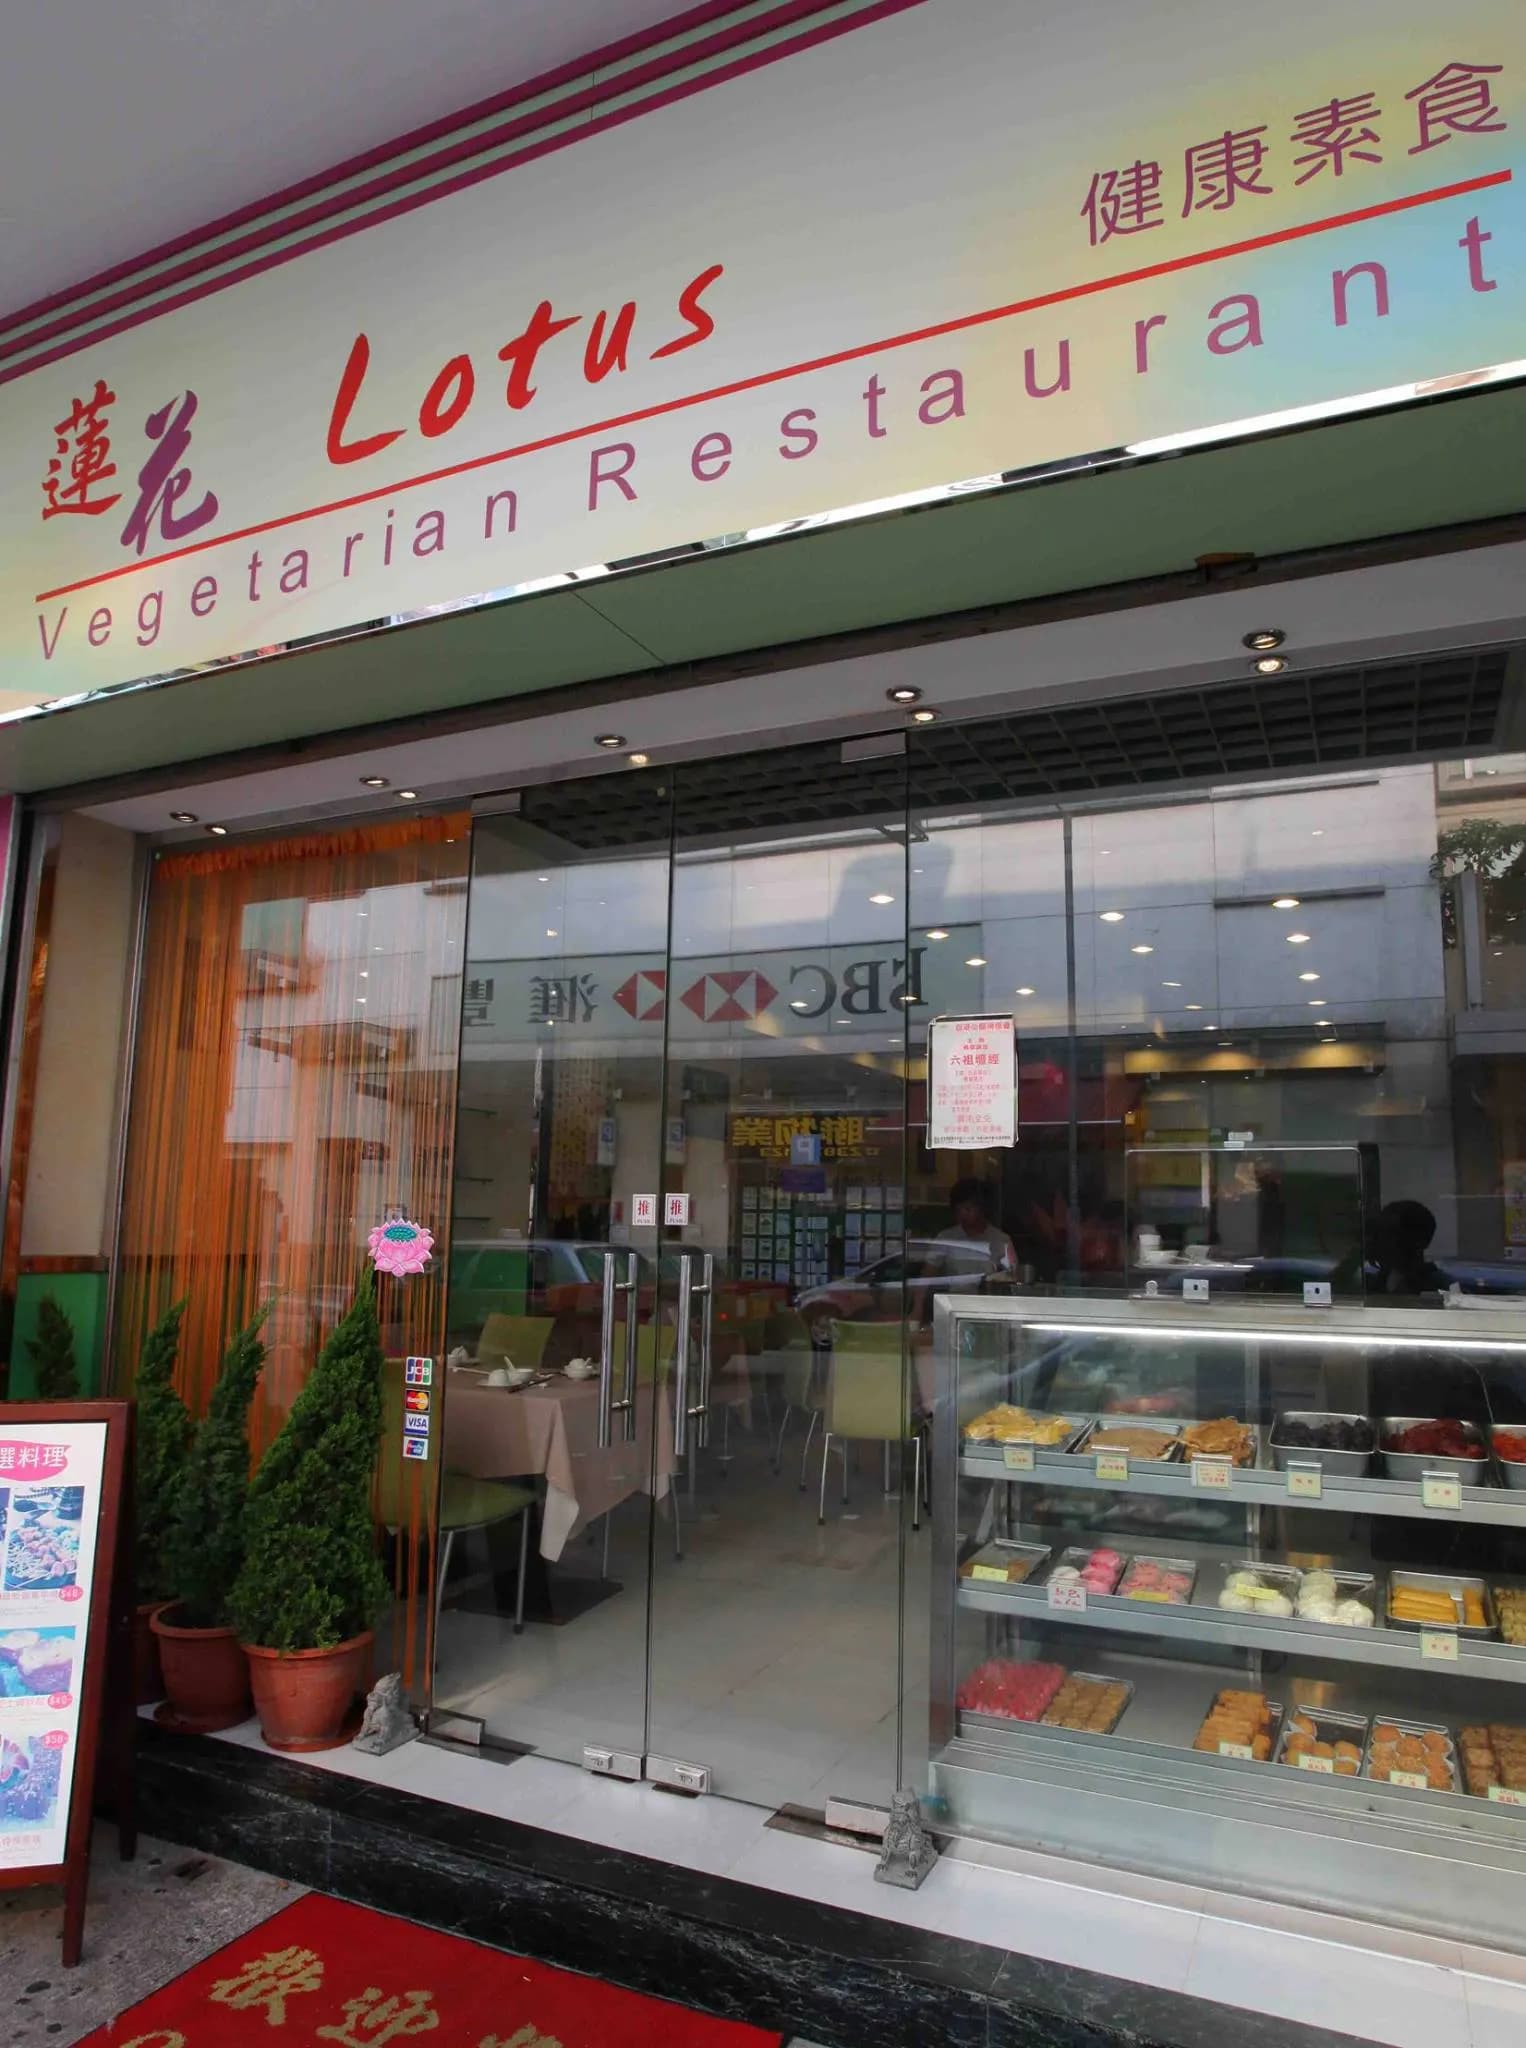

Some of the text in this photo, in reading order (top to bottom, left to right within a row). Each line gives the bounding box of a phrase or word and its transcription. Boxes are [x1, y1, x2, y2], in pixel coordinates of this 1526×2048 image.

[1081, 62, 1507, 246] 健康素食
[38, 216, 1497, 660] Vegetarian Restaurant
[326, 264, 724, 465] Lotus
[41, 379, 219, 554] 蓮花
[638, 1200, 648, 1216] 推
[671, 1200, 682, 1216] 推
[409, 1418, 427, 1427] VISA
